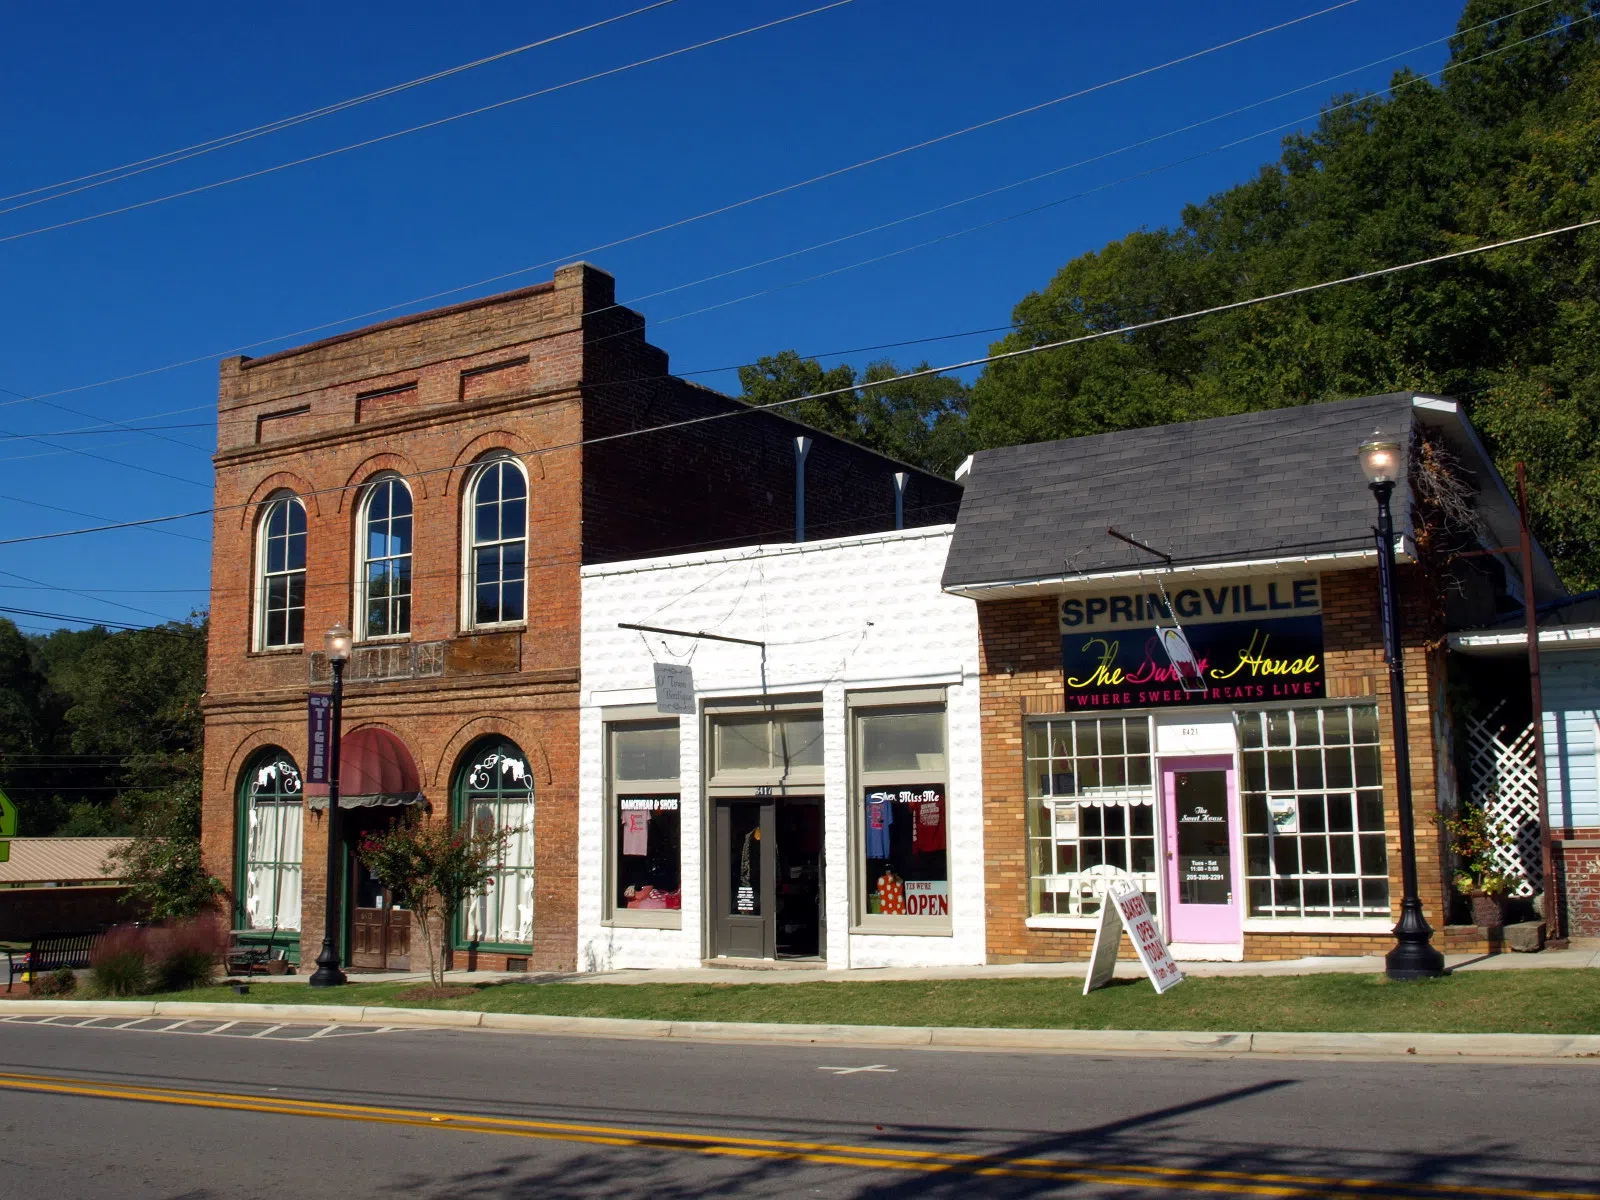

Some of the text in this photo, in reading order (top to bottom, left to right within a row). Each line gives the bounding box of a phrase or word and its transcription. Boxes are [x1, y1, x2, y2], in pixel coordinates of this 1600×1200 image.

[1061, 579, 1321, 627] SPRINGVILLE
[1068, 629, 1320, 688] The Swet House
[1139, 689, 1191, 704] SWEET
[1202, 685, 1264, 699] TREATS
[313, 707, 325, 779] TIGERS
[620, 799, 653, 811] DANCEWEAR
[660, 799, 679, 811] SHOES
[899, 790, 923, 803] Miss
[922, 789, 940, 803] Me
[1181, 814, 1224, 822] Sweet House
[1194, 806, 1208, 815] The
[906, 882, 916, 891] YES
[907, 894, 949, 916] OPEN
[1120, 895, 1149, 921] BAKERY
[1135, 919, 1157, 943] OPEN
[1143, 938, 1168, 964] TODAY
